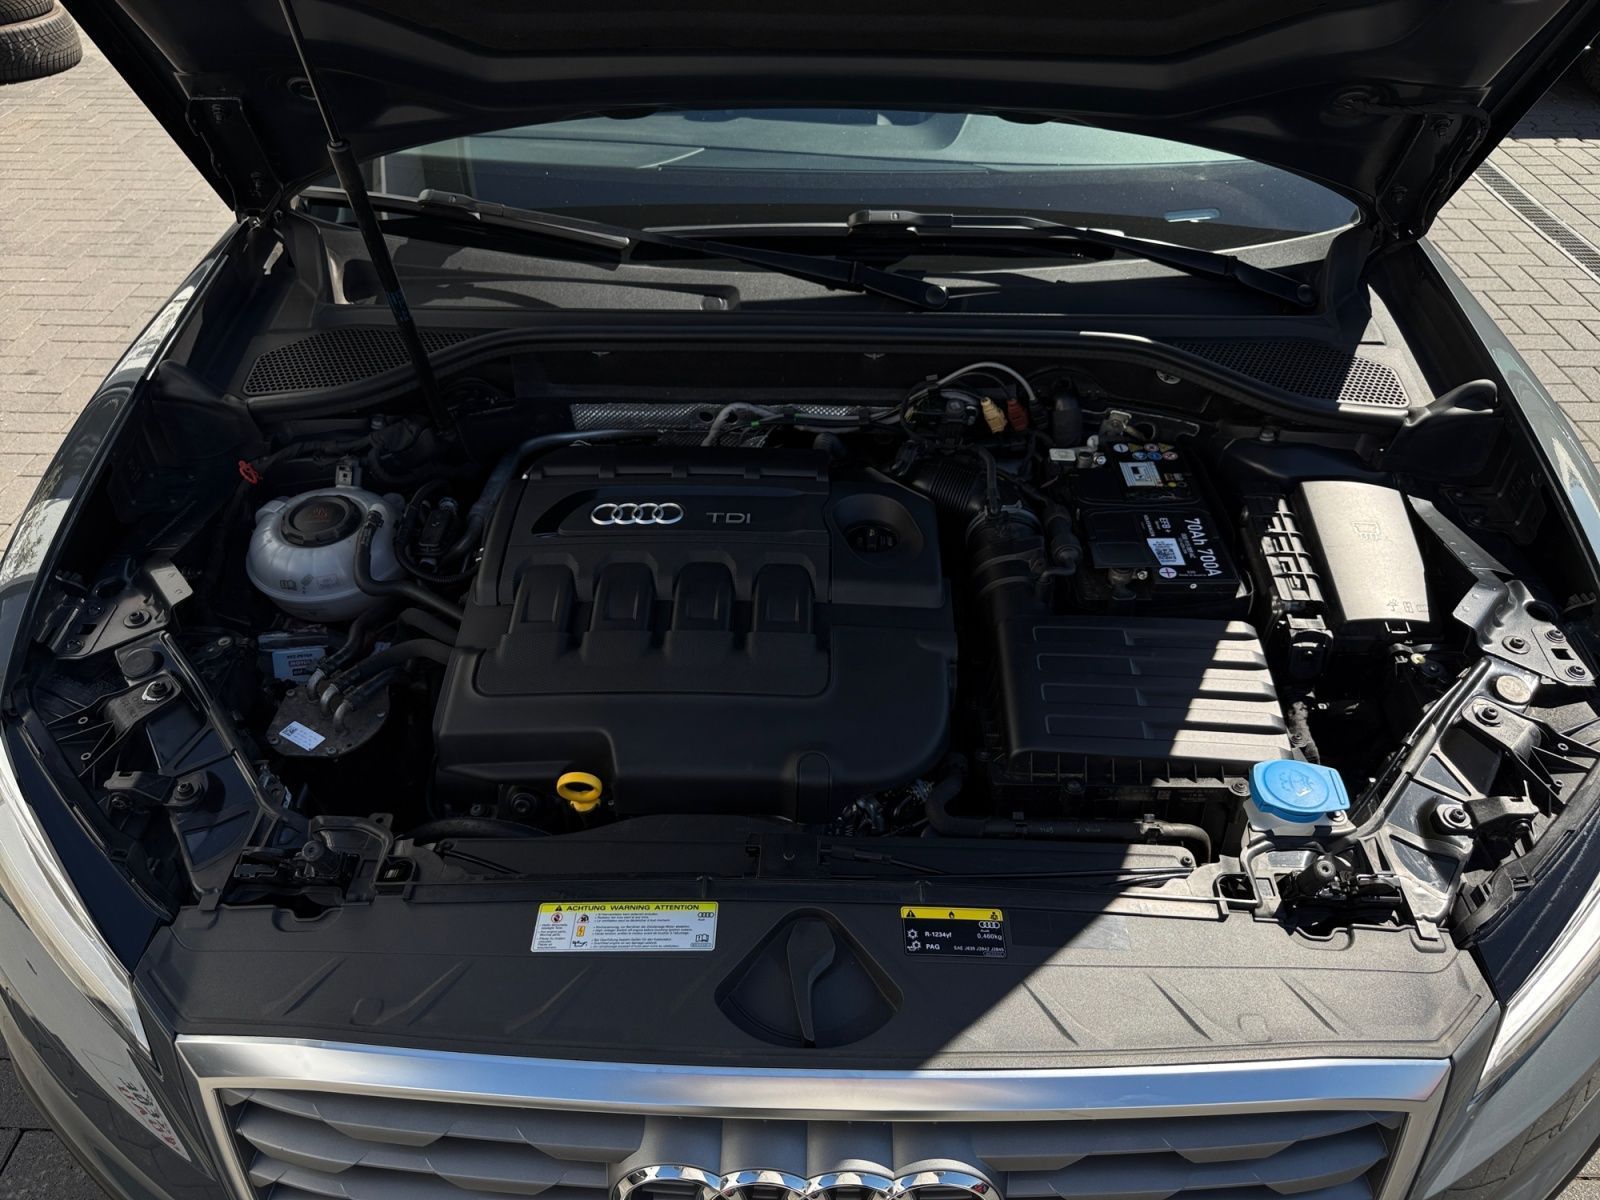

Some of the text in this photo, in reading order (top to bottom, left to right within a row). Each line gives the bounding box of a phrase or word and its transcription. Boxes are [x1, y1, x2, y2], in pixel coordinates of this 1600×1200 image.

[705, 512, 751, 524] TDI
[1159, 517, 1171, 529] EFB
[1184, 518, 1208, 546] 70Ah
[1197, 548, 1223, 577] 700A
[924, 931, 952, 939] R-1234yf
